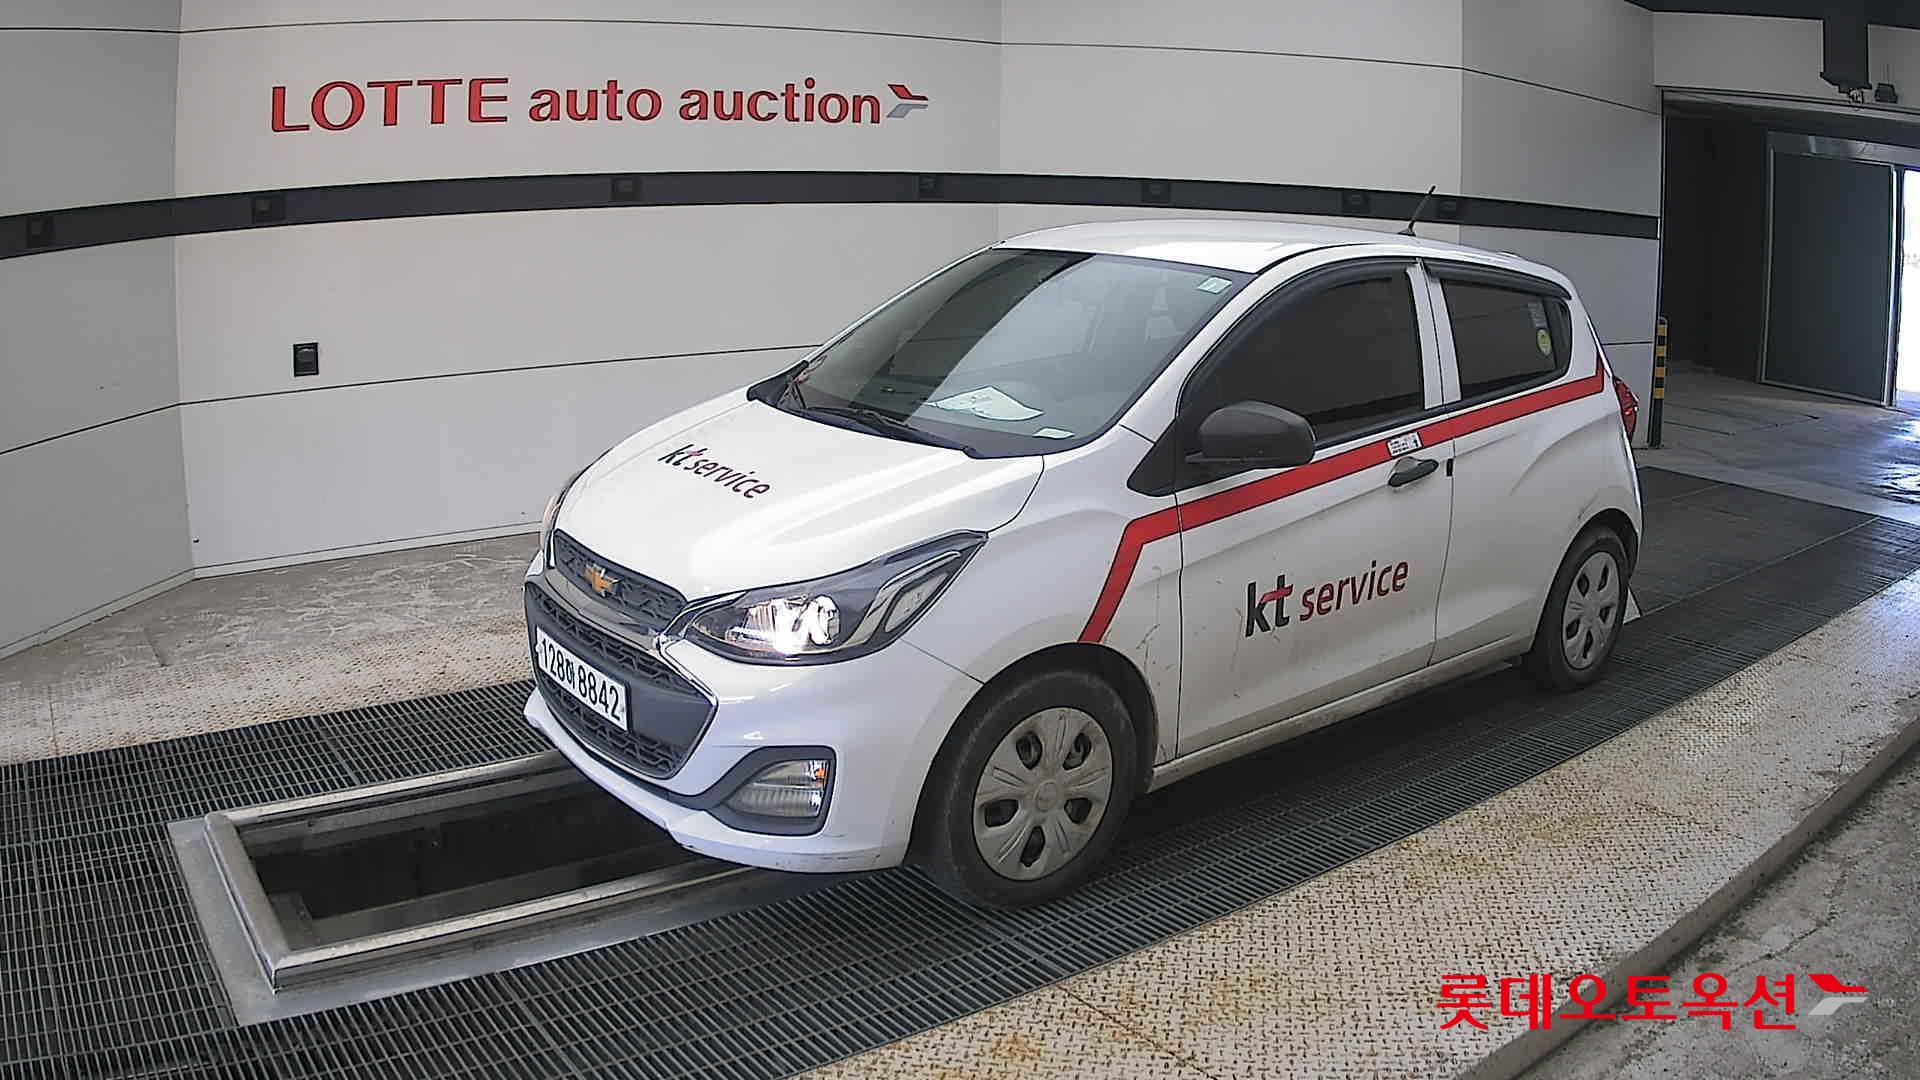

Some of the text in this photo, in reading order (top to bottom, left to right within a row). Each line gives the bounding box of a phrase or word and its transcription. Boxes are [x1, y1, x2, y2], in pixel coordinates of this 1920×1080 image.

[271, 77, 880, 133] LOTTE auto auction
[657, 443, 770, 499] kt service
[1245, 560, 1409, 637] kt service
[578, 664, 621, 721] 8842
